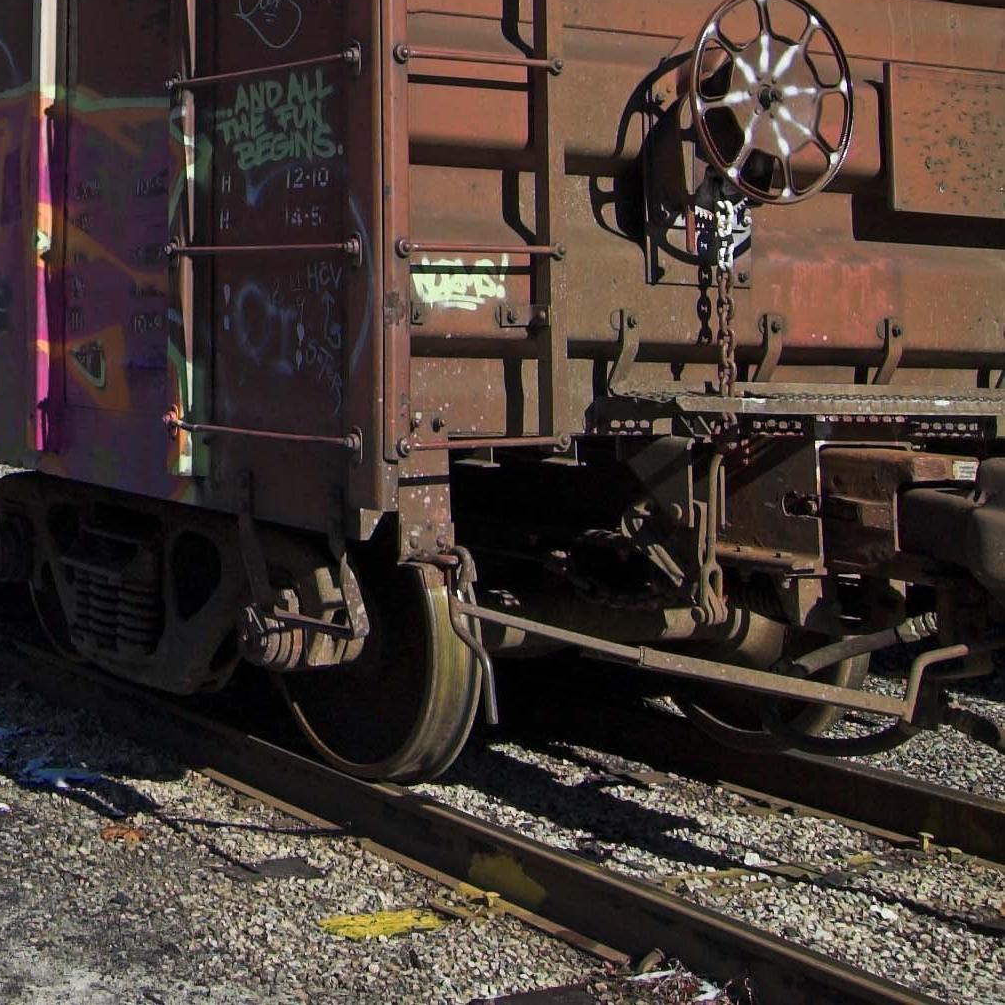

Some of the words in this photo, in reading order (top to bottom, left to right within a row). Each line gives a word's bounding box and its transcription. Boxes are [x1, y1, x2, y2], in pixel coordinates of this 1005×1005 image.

[287, 68, 334, 104] ALL
[216, 111, 267, 146] THE
[274, 101, 324, 132] FUN
